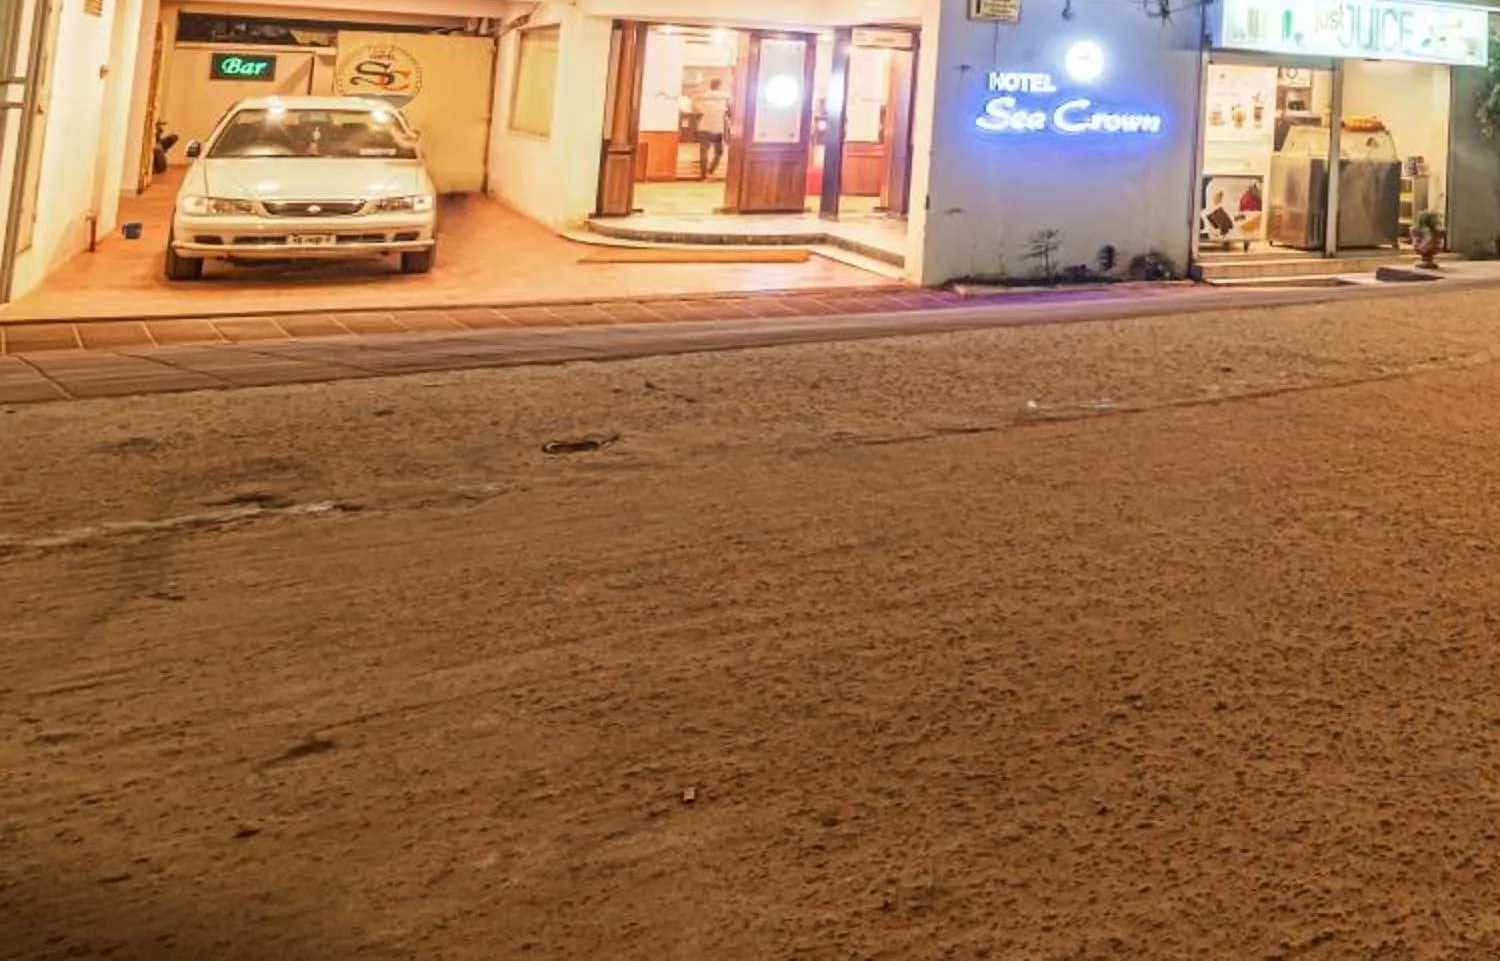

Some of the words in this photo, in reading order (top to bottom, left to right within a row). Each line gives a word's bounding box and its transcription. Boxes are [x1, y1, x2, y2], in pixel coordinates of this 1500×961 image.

[1338, 4, 1415, 52] JUICE
[221, 57, 268, 75] Bar
[988, 71, 1057, 92] HOTEL
[975, 96, 1047, 130] Sea
[1053, 98, 1162, 133] Crown
